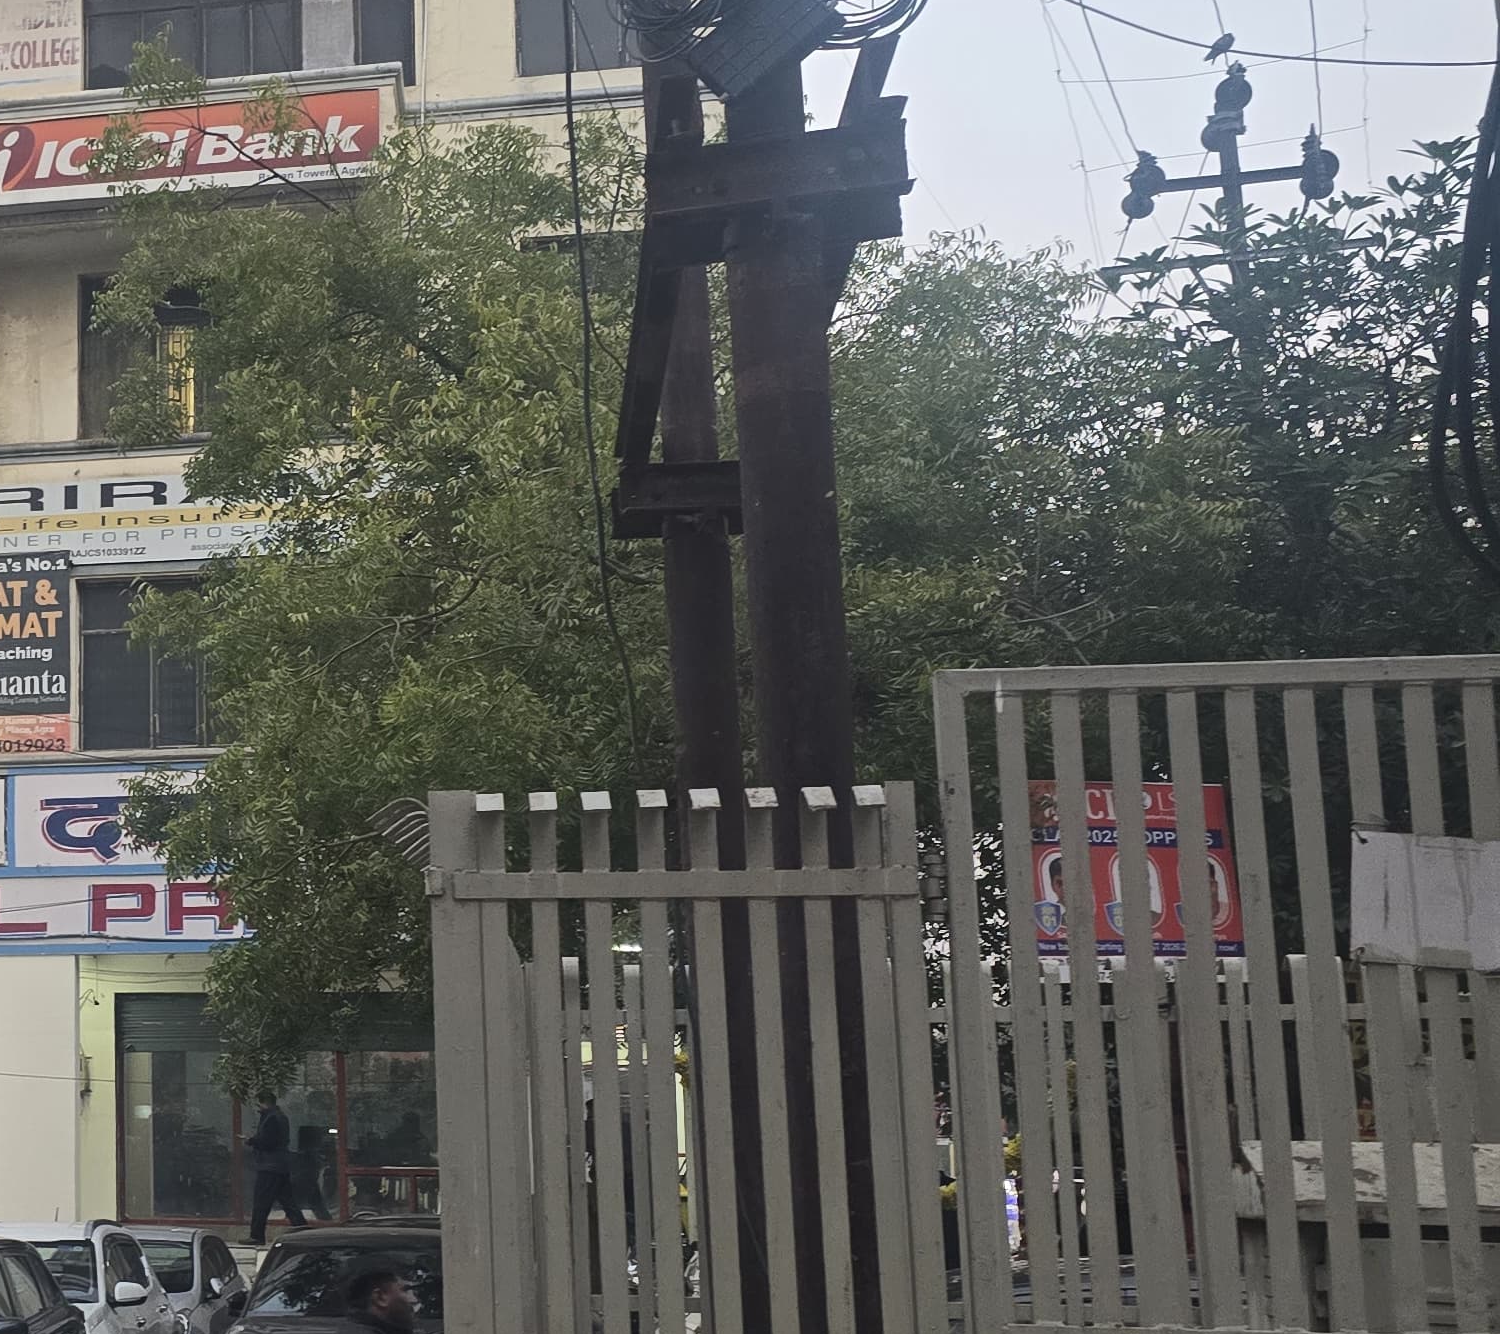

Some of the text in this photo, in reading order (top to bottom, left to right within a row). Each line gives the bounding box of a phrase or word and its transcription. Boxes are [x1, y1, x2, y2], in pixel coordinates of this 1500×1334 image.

[11, 37, 80, 70] COLLEGE
[197, 115, 364, 165] Bank
[83, 529, 140, 544] FOR
[25, 557, 68, 572] No.1
[34, 578, 60, 605] &
